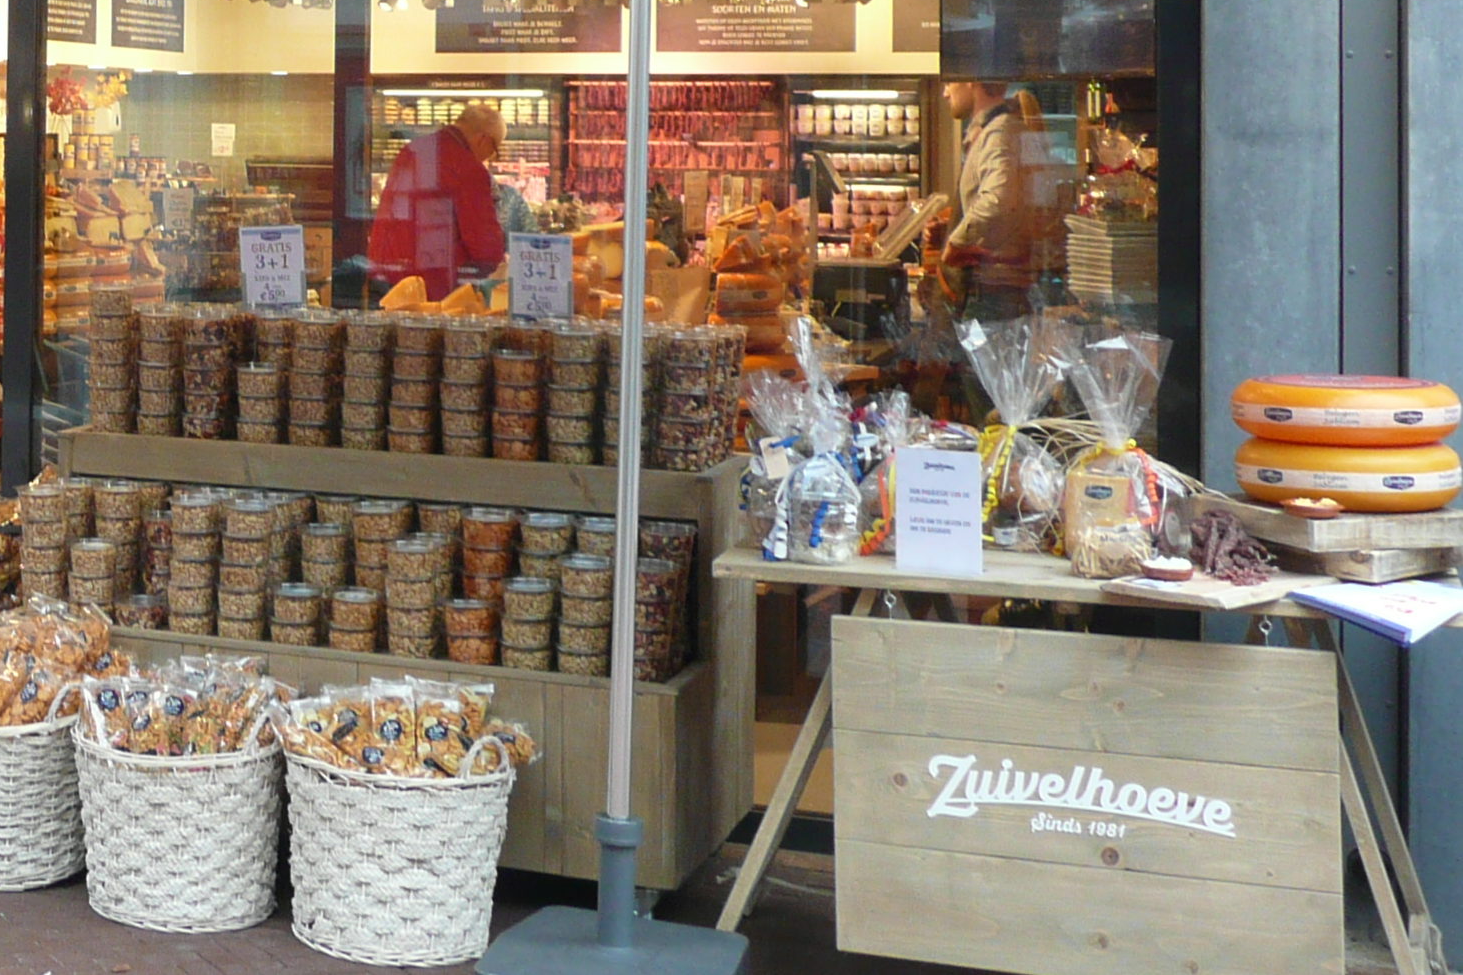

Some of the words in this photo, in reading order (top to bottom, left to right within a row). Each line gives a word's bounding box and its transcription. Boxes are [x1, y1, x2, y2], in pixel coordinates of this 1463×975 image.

[251, 242, 292, 254] GRATIS
[520, 250, 560, 263] GRATIS
[926, 754, 1236, 838] Zuivelhoeve
[1031, 812, 1081, 834] Sinds
[1088, 820, 1126, 838] 1981
